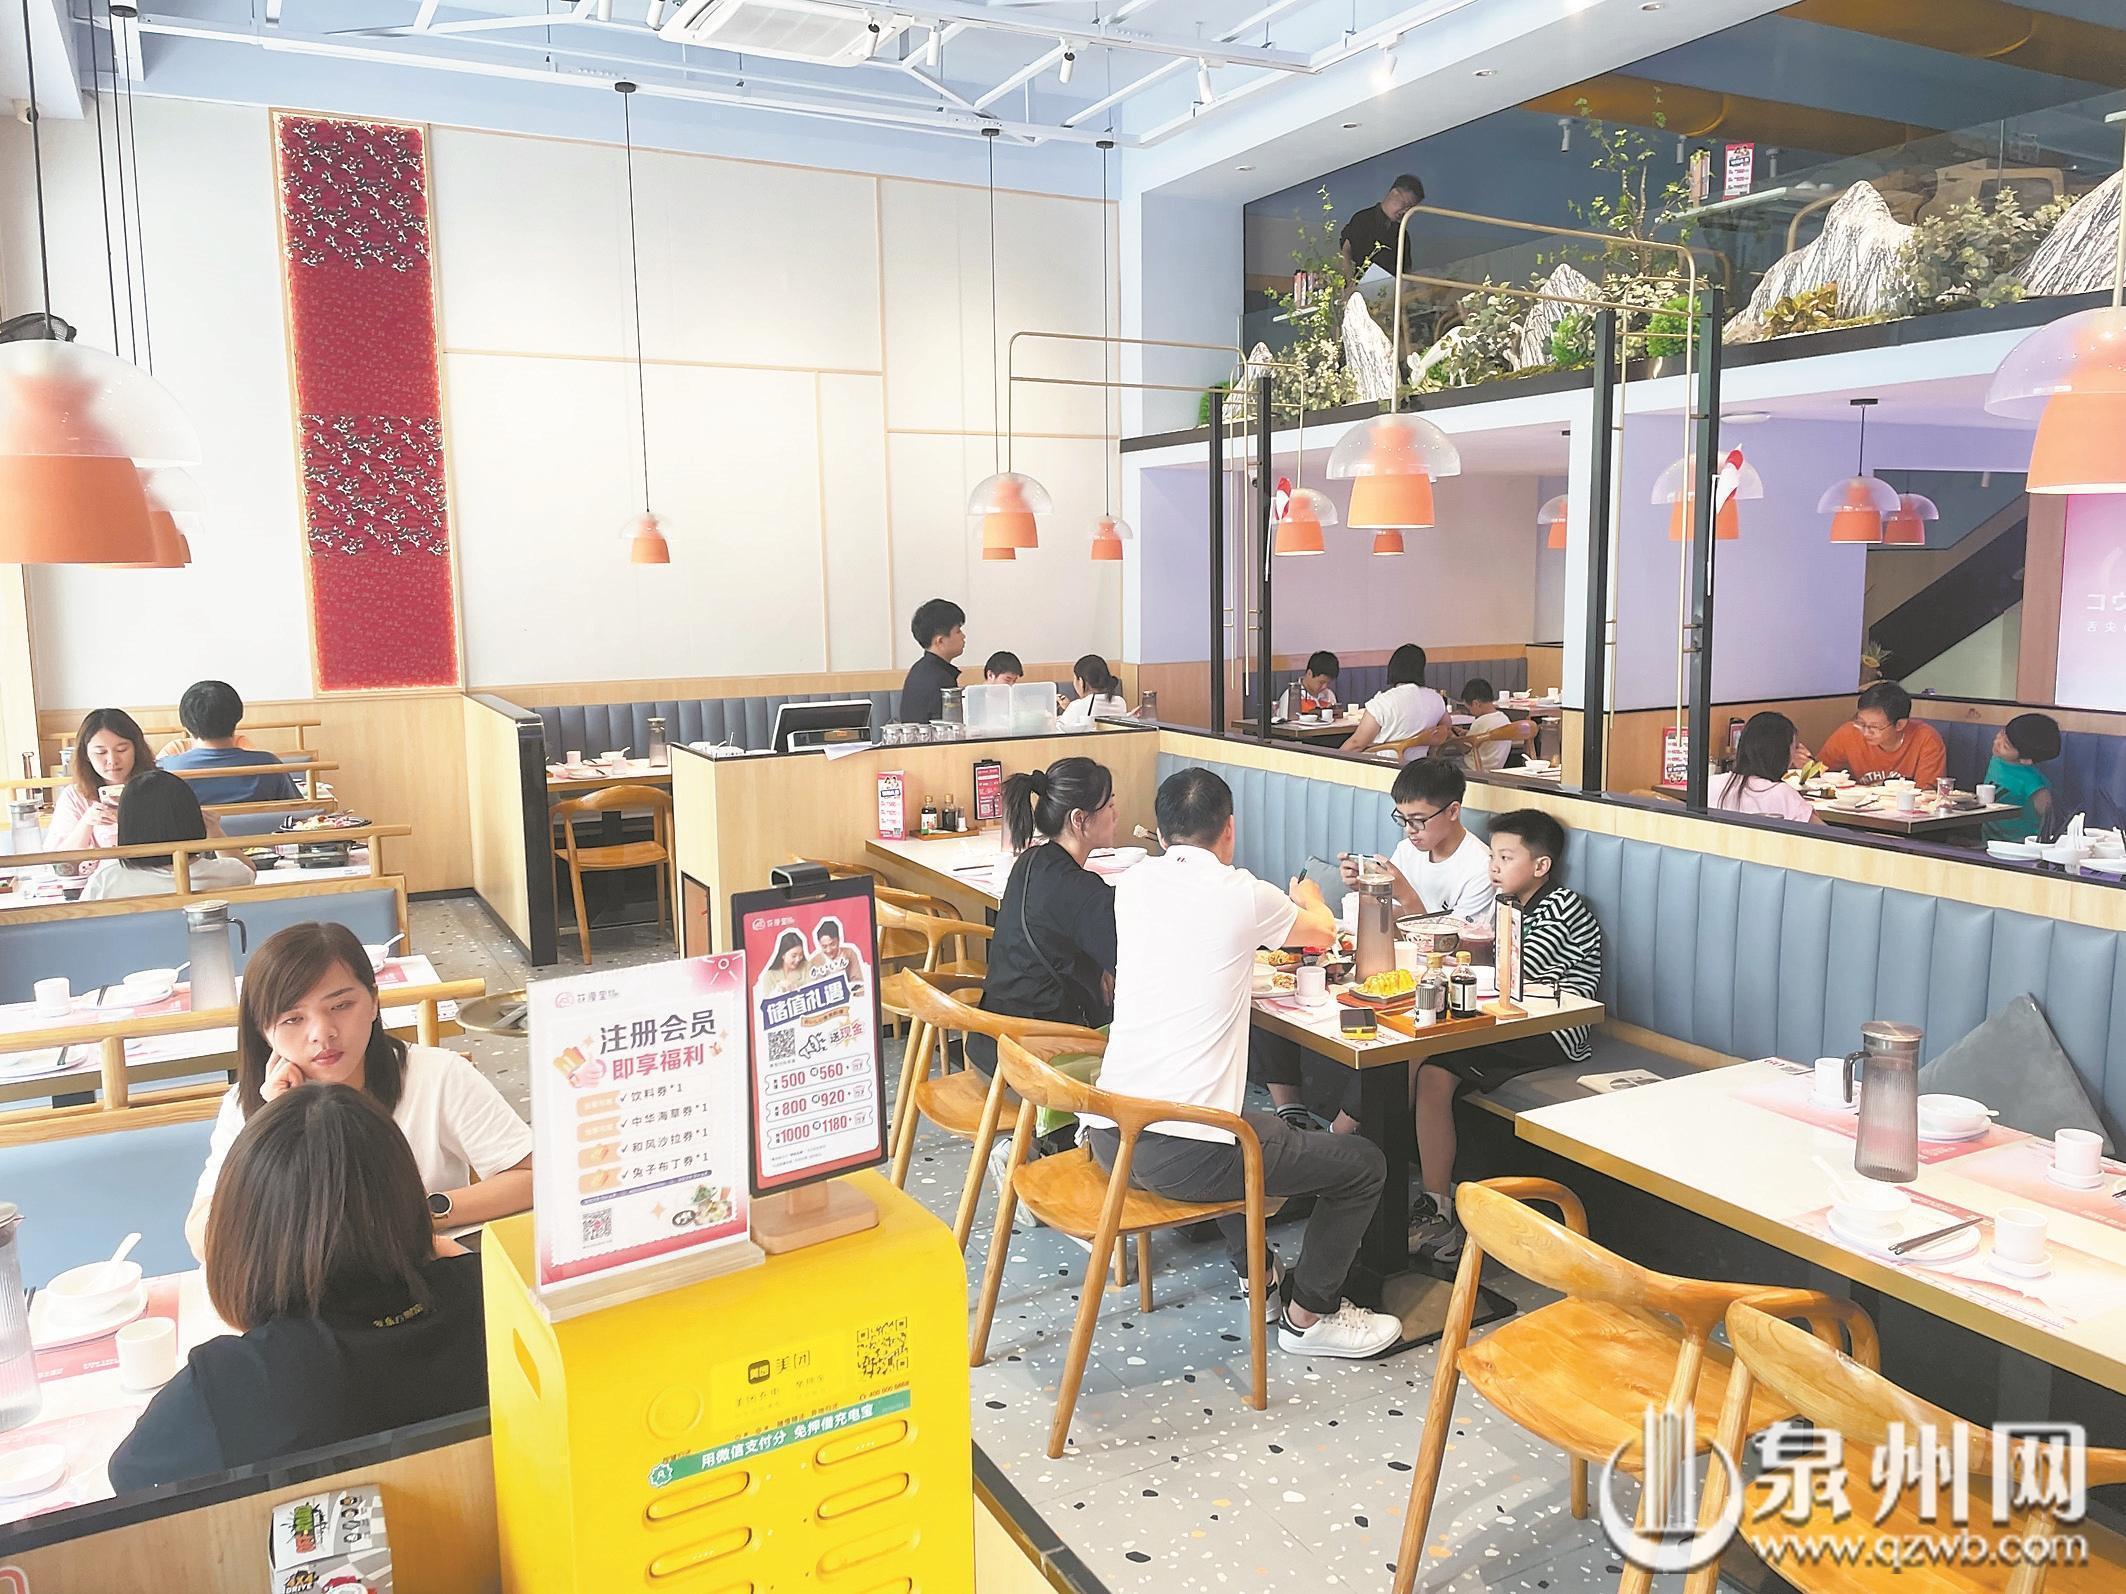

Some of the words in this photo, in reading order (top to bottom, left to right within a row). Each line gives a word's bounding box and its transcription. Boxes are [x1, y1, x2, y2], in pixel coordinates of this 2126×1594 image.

[766, 980, 845, 1025] 储值礼遇
[600, 1009, 716, 1054] 注册会员
[830, 1022, 863, 1043] 送现金
[612, 1043, 704, 1080] 即享福利
[781, 1071, 806, 1089] 500
[820, 1062, 843, 1080] 560
[782, 1098, 807, 1116] 800
[821, 1089, 845, 1107] 920
[781, 1124, 810, 1143] 1000
[822, 1115, 847, 1133] 1180
[701, 1430, 787, 1468] 用微信支付分
[793, 1403, 874, 1440] 免押借充电宝
